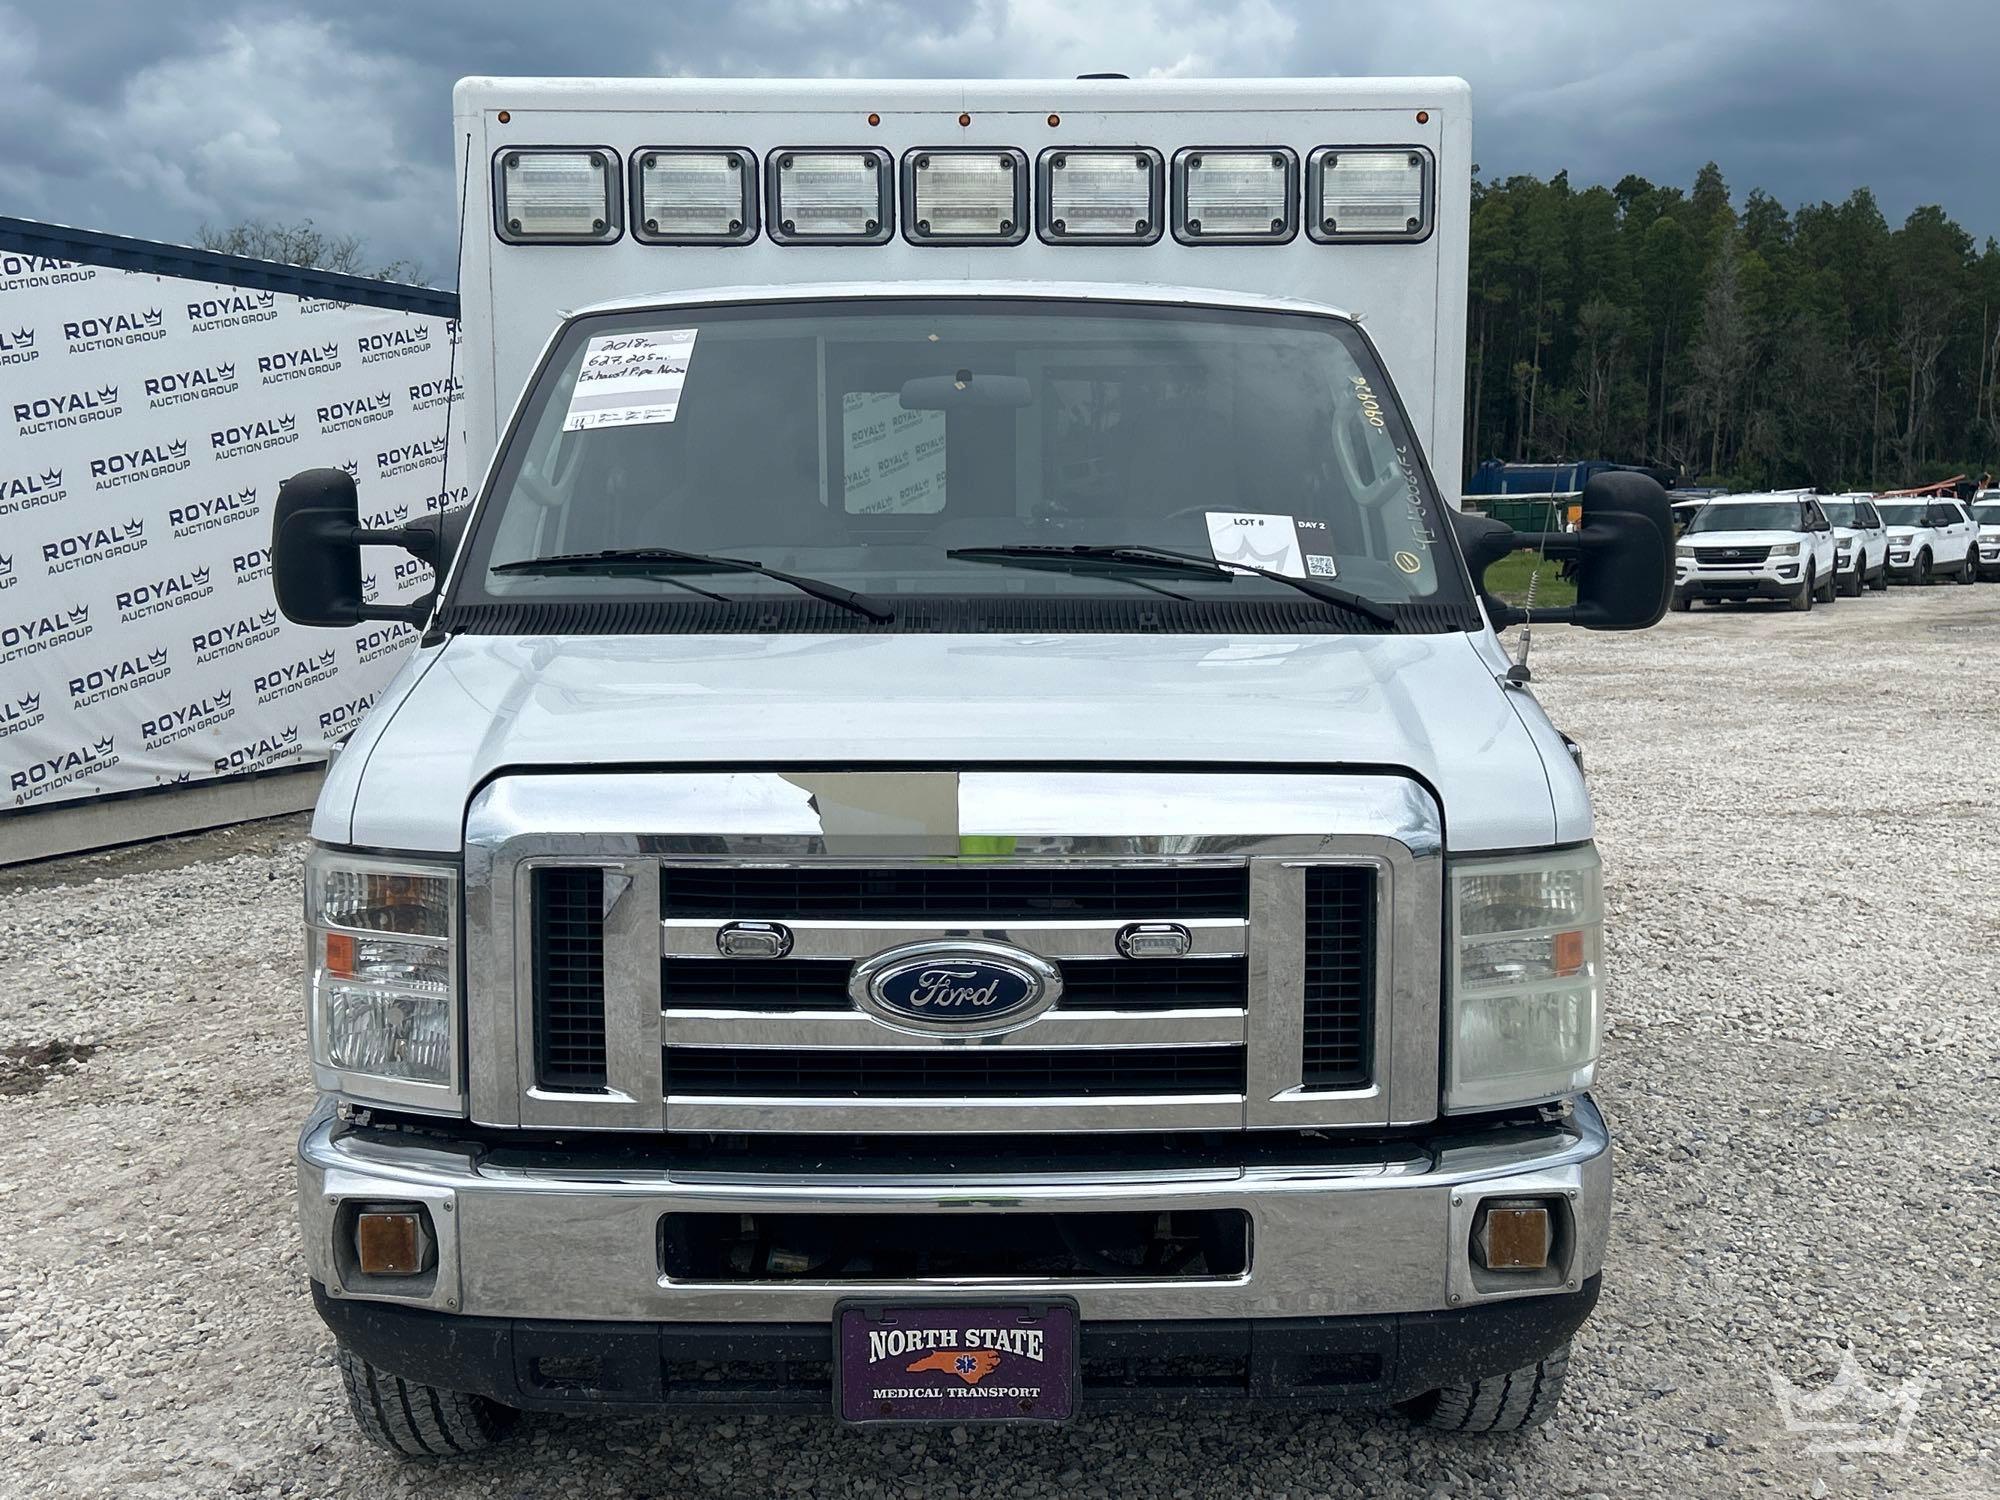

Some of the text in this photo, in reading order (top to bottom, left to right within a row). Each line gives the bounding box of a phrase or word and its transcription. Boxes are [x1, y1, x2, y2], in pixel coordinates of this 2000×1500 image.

[0, 270, 96, 291] UCTION GROUP
[187, 295, 258, 320] ROYAL
[63, 313, 144, 340] ROYAL
[192, 311, 278, 333] AUCTION GROUP
[69, 329, 167, 354] AUCTION GROUP
[358, 329, 415, 353] ROYAL
[362, 343, 431, 365] AUCTION GROUP
[0, 351, 39, 365] ROUP
[258, 347, 323, 373] ROYAL
[144, 368, 218, 396] ROYAL
[262, 361, 342, 385] AUCTION GROUP
[149, 382, 239, 410] AUCTION GROUP
[409, 377, 463, 400] ROYAL
[14, 391, 98, 422] ROYAL
[317, 397, 377, 423] ROYAL
[19, 407, 123, 436] AUCTION GROUP
[211, 419, 280, 449] ROYAL
[321, 409, 394, 435] AUCTION GROUP
[852, 424, 880, 443] ROYAL
[215, 433, 299, 461] AUCTION GROUP
[377, 441, 432, 468] ROYAL
[90, 446, 169, 477] ROYAL
[95, 459, 191, 491] AUCTION GROUP
[380, 462, 418, 479] AUCTION
[21, 490, 67, 509] GROUP
[169, 494, 240, 526] ROYAL
[426, 487, 468, 511] ROYA
[174, 506, 260, 539] AUCTION GROUP
[1233, 518, 1255, 526] LOT
[1297, 521, 1326, 530] DAY 2
[42, 525, 124, 562] ROYAL
[48, 539, 148, 575] AUCTION GROUP
[232, 547, 272, 573] ROY
[116, 574, 193, 610] ROYAL
[121, 586, 214, 624] AUCTION GROUP
[1, 614, 70, 647] OYAL
[192, 616, 261, 652] ROYAL
[356, 622, 412, 653] ROYAL
[0, 625, 93, 665] UCTION GROUP
[196, 626, 280, 665] AUCTION GROUP
[359, 641, 398, 664] AUCTION
[69, 657, 149, 696] ROYAL
[73, 667, 172, 711] AUCTION GROUP
[253, 657, 321, 693] ROYAL
[257, 667, 339, 706] AUCTION GROUP
[141, 699, 215, 739] ROYAL
[145, 708, 235, 752] AUCTION GROUP
[214, 735, 283, 774] ROYAL
[266, 743, 303, 765] GROUP
[11, 746, 97, 791] ROYAL
[15, 755, 120, 805] AUCTION GROUP
[909, 970, 999, 1007] Ford
[869, 1329, 1044, 1364] NORTH STATE
[872, 1387, 1041, 1399] MEDICAL TRANSPORT
